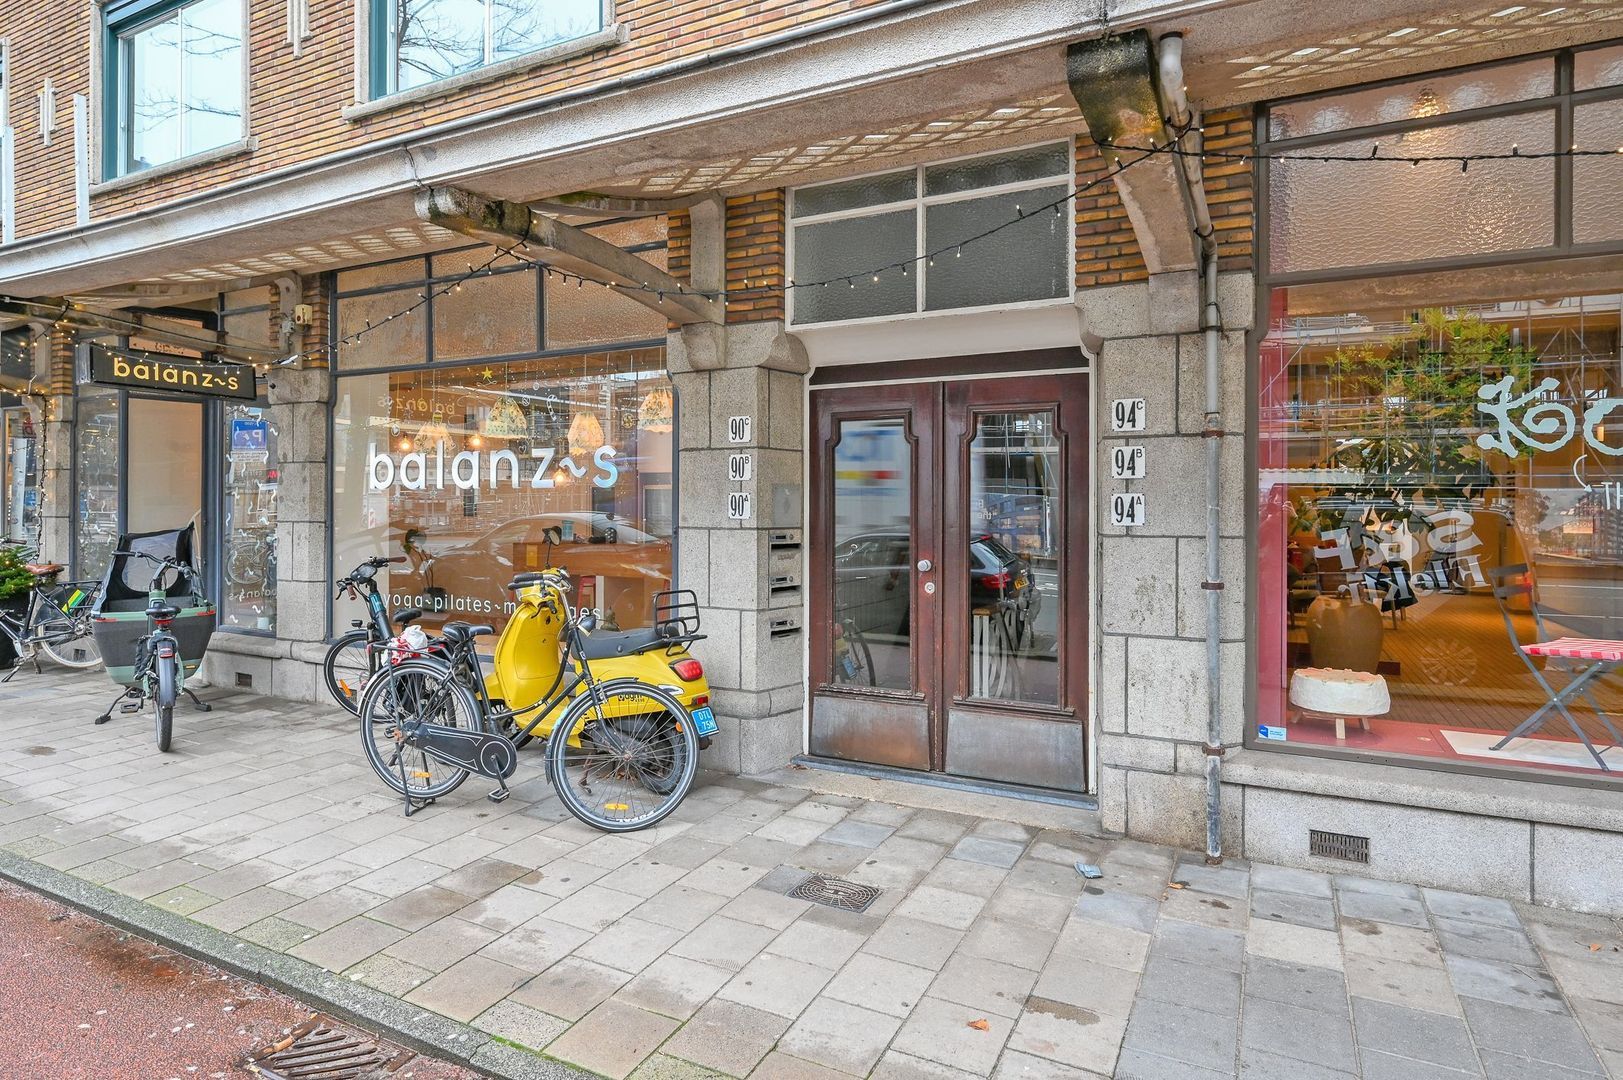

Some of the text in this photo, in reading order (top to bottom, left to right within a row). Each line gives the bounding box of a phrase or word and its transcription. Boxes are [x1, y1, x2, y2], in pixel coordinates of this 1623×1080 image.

[1115, 401, 1144, 428] 94C
[730, 418, 750, 440] 90C
[369, 440, 619, 490] balanz~s
[730, 456, 750, 479] 90B
[1114, 448, 1143, 476] 94B
[730, 494, 749, 517] 90A
[1114, 496, 1142, 524] 94A
